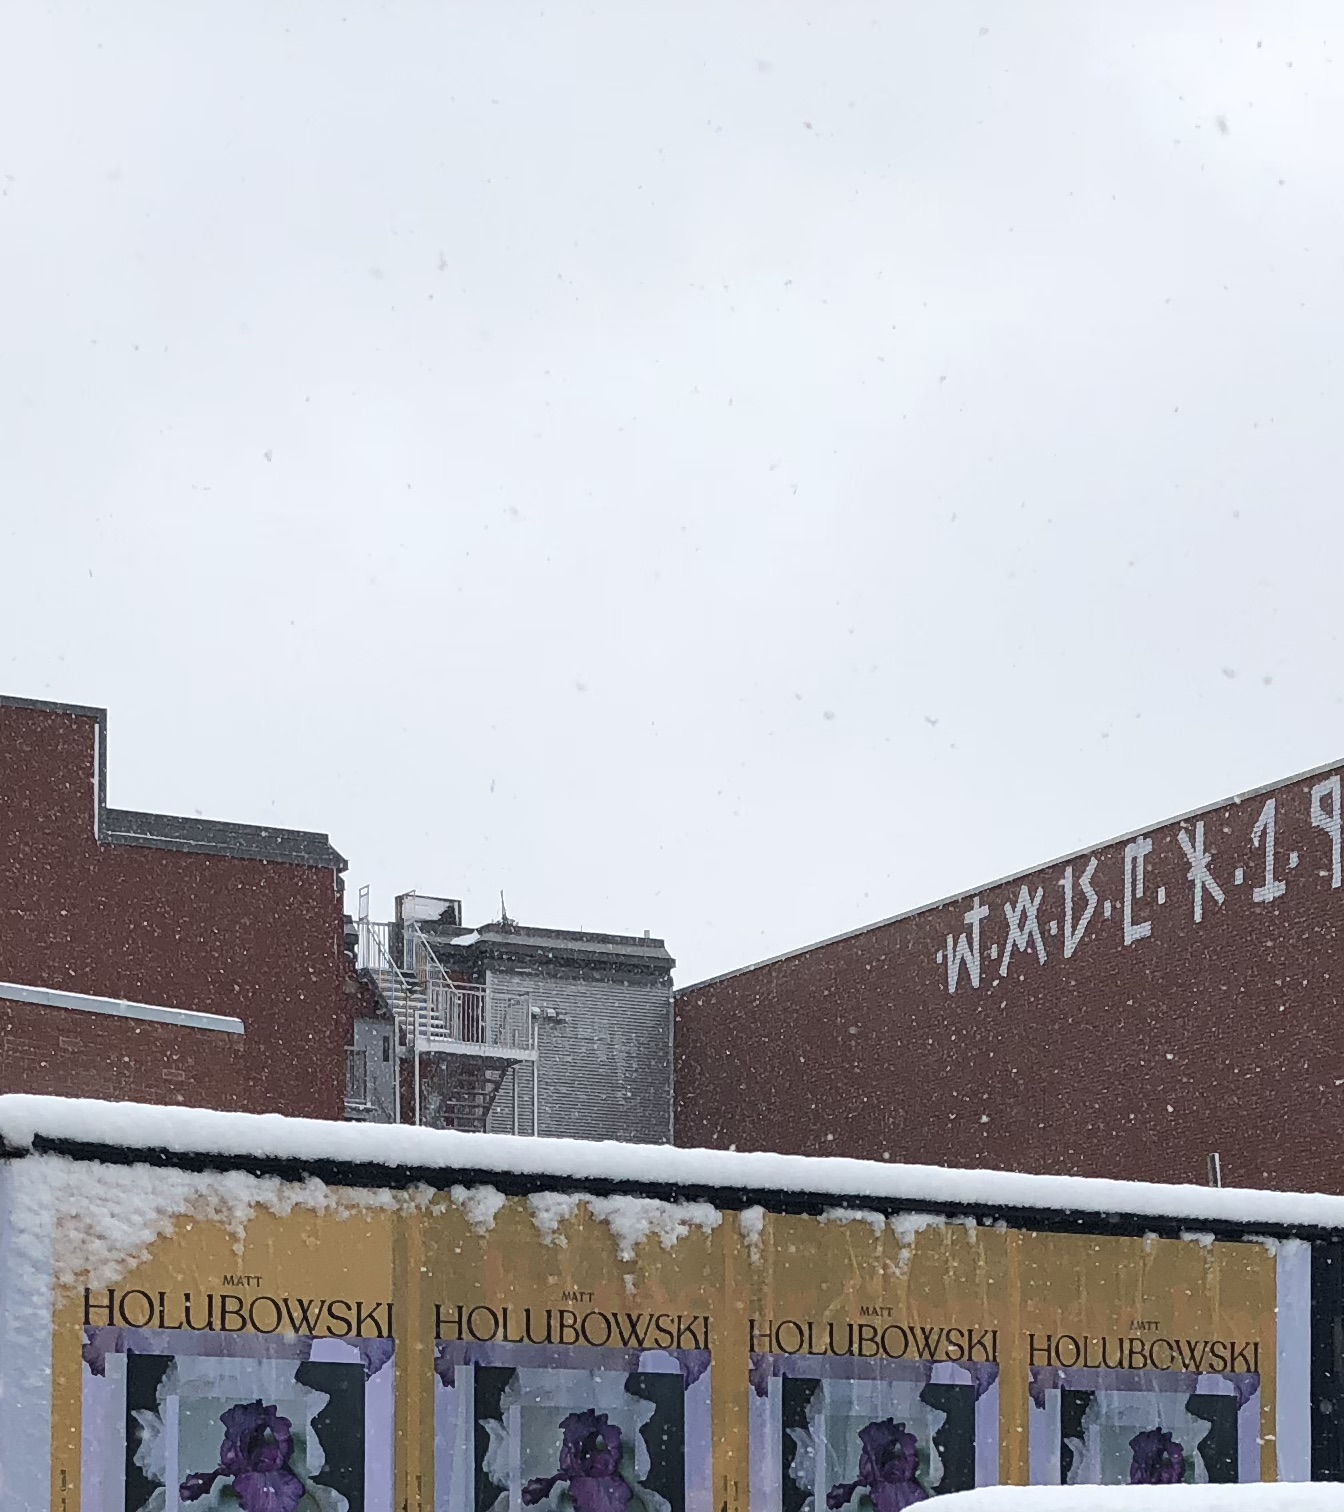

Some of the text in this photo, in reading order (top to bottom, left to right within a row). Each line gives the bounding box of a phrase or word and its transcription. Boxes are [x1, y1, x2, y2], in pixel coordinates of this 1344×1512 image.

[222, 1274, 263, 1289] MATT
[561, 1290, 595, 1303] MATT
[81, 1288, 395, 1339] HOLUBOWSKI
[434, 1302, 711, 1351] HOLUBOWSKI
[859, 1306, 893, 1318] MATT
[749, 1318, 999, 1364] HOLUBOWSKI
[1028, 1334, 1261, 1373] HOLUBOWSKI
